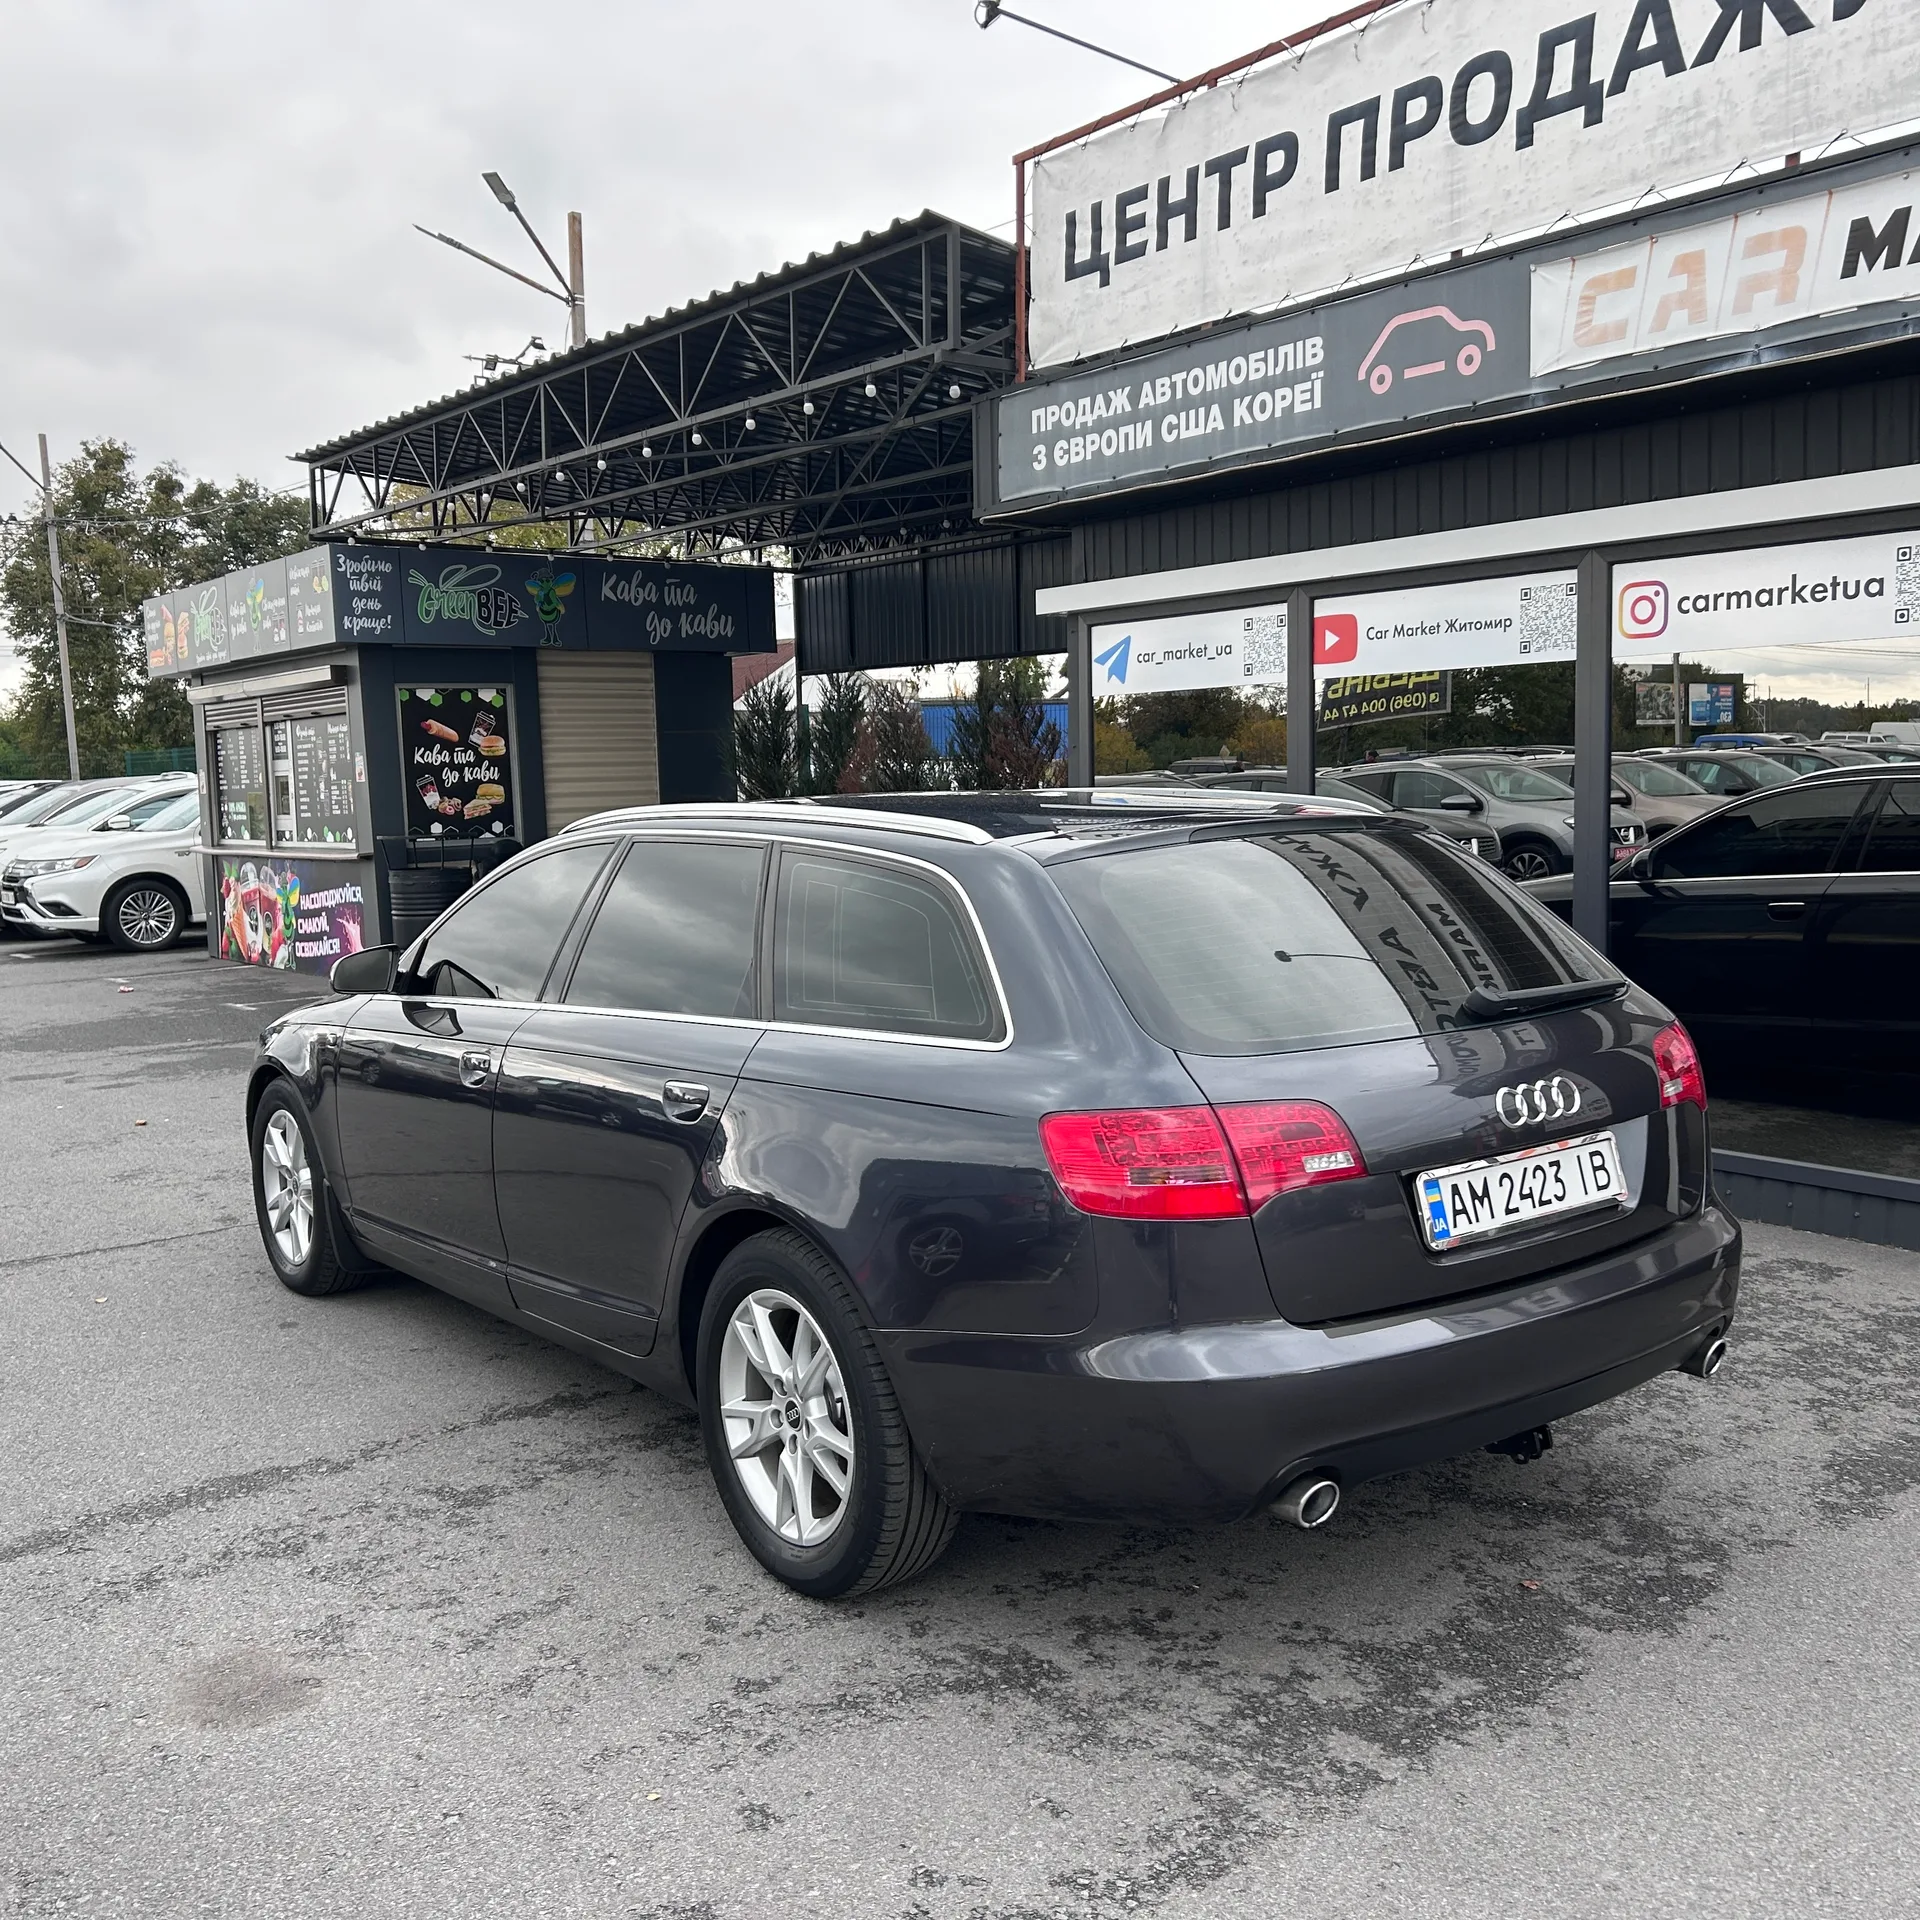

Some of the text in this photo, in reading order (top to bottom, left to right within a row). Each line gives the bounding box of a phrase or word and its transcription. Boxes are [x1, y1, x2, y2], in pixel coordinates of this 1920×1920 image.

[1065, 0, 1866, 286] ЦЕНТР ПРОДАЖ
[1573, 205, 1920, 348] CAR M
[1031, 336, 1324, 434] ПРОДАЖ АВТОМОБІЛІВ
[1032, 370, 1324, 471] З ЄВРОПИ США КОРЕЇ
[349, 575, 383, 592] твій
[601, 569, 698, 607] Кава та
[1677, 573, 1885, 615] carmarketua
[342, 614, 392, 636] краще!
[352, 597, 383, 617] день
[645, 603, 735, 644] до кави
[1366, 617, 1513, 640] Car Market Житомир
[1136, 641, 1232, 664] car_market_ua
[413, 743, 476, 766] Кава та
[442, 760, 500, 788] до кави
[1451, 1150, 1611, 1228] AM 2423 IB
